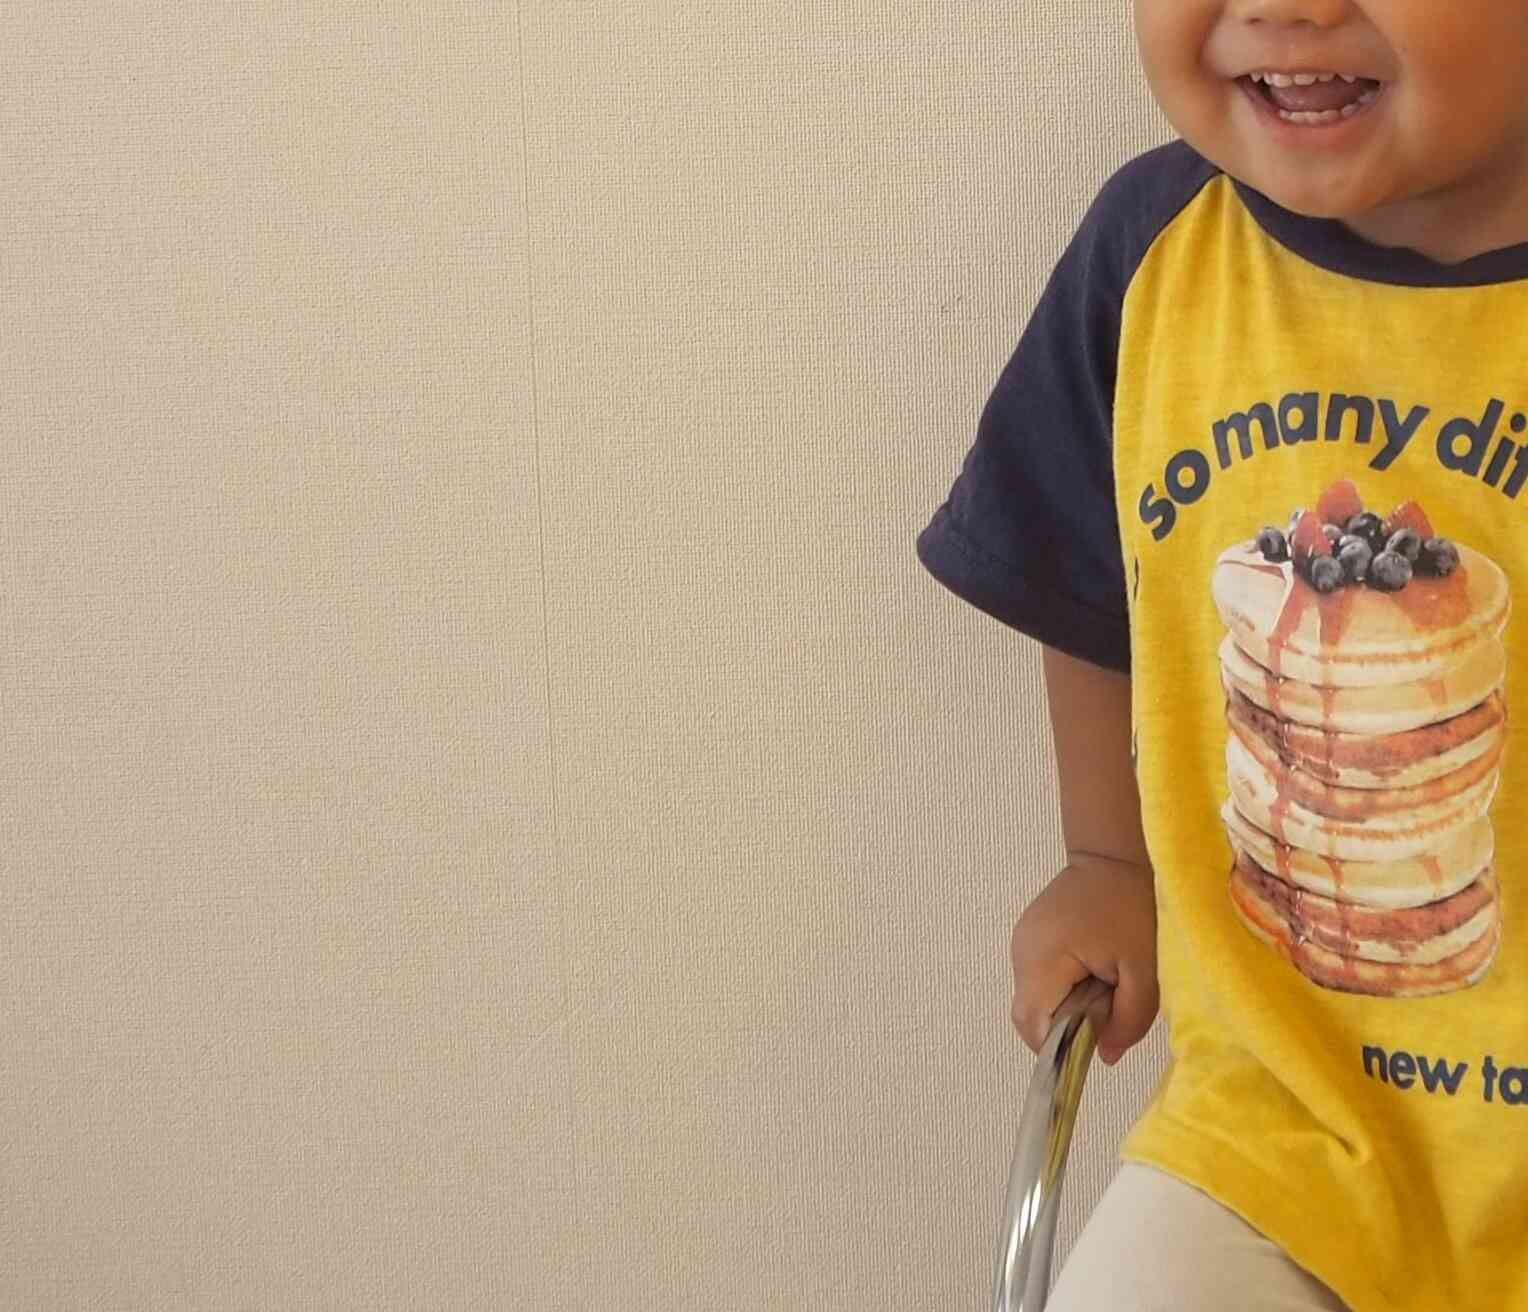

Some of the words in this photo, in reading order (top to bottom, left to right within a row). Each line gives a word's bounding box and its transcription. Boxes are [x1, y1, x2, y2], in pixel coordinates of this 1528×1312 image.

[1138, 449, 1211, 541] so
[1212, 390, 1430, 470] many
[1361, 1044, 1469, 1093] new
